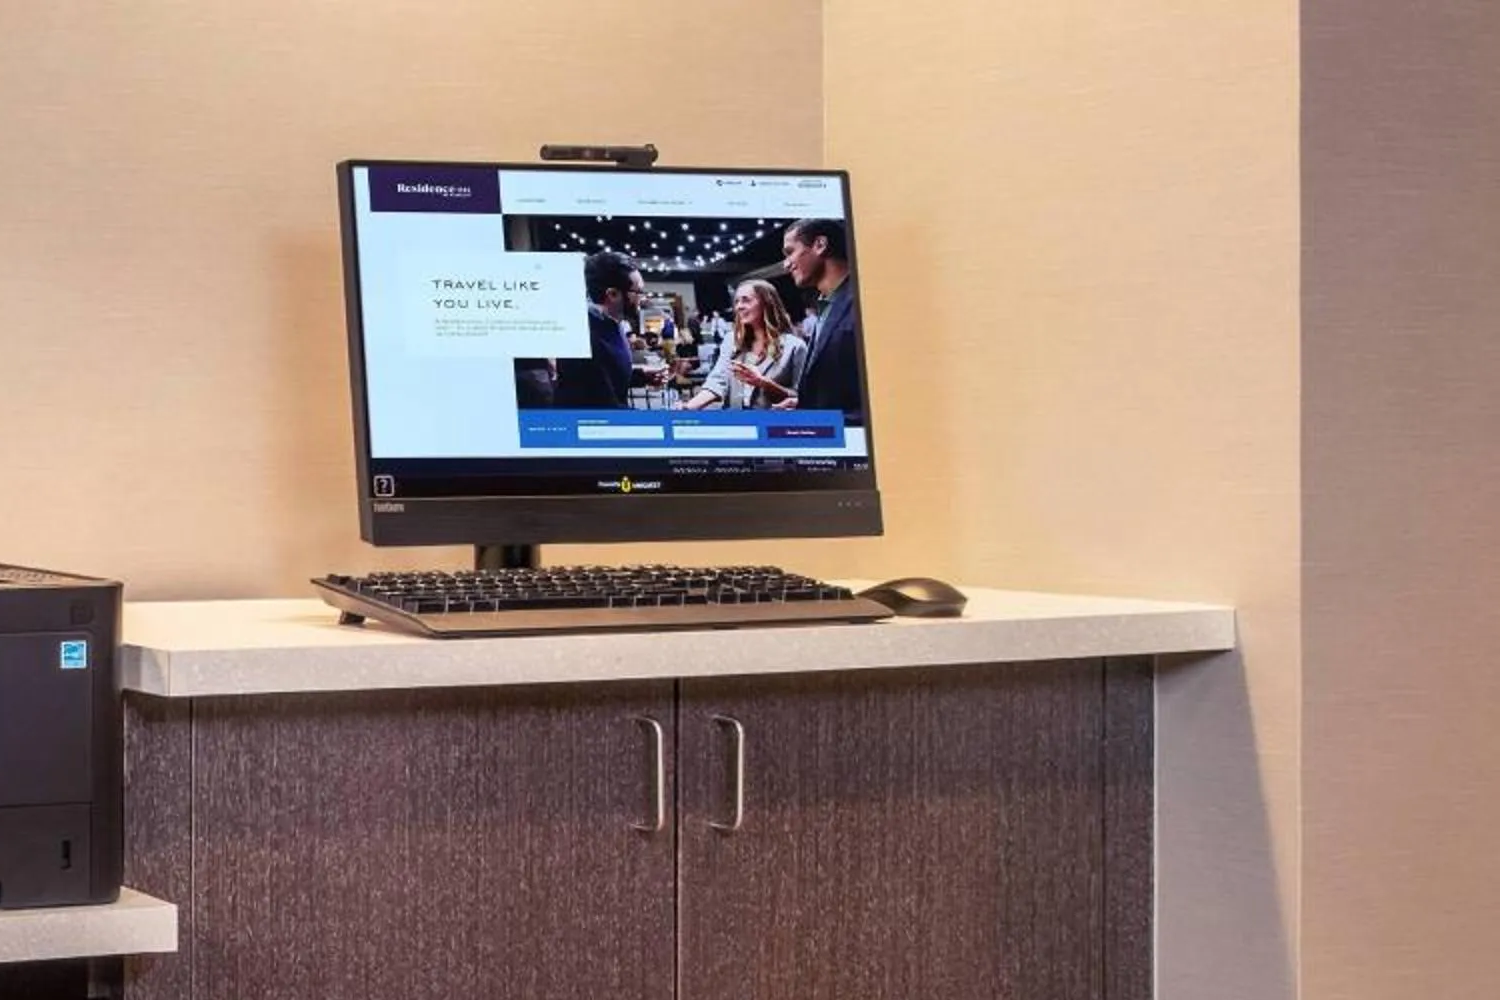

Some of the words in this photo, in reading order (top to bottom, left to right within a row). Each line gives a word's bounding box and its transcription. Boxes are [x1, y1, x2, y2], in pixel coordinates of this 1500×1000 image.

[432, 279, 498, 291] TRAVEL
[503, 280, 541, 291] LIKE
[433, 299, 469, 309] YOU
[477, 299, 520, 310] LIVE.
